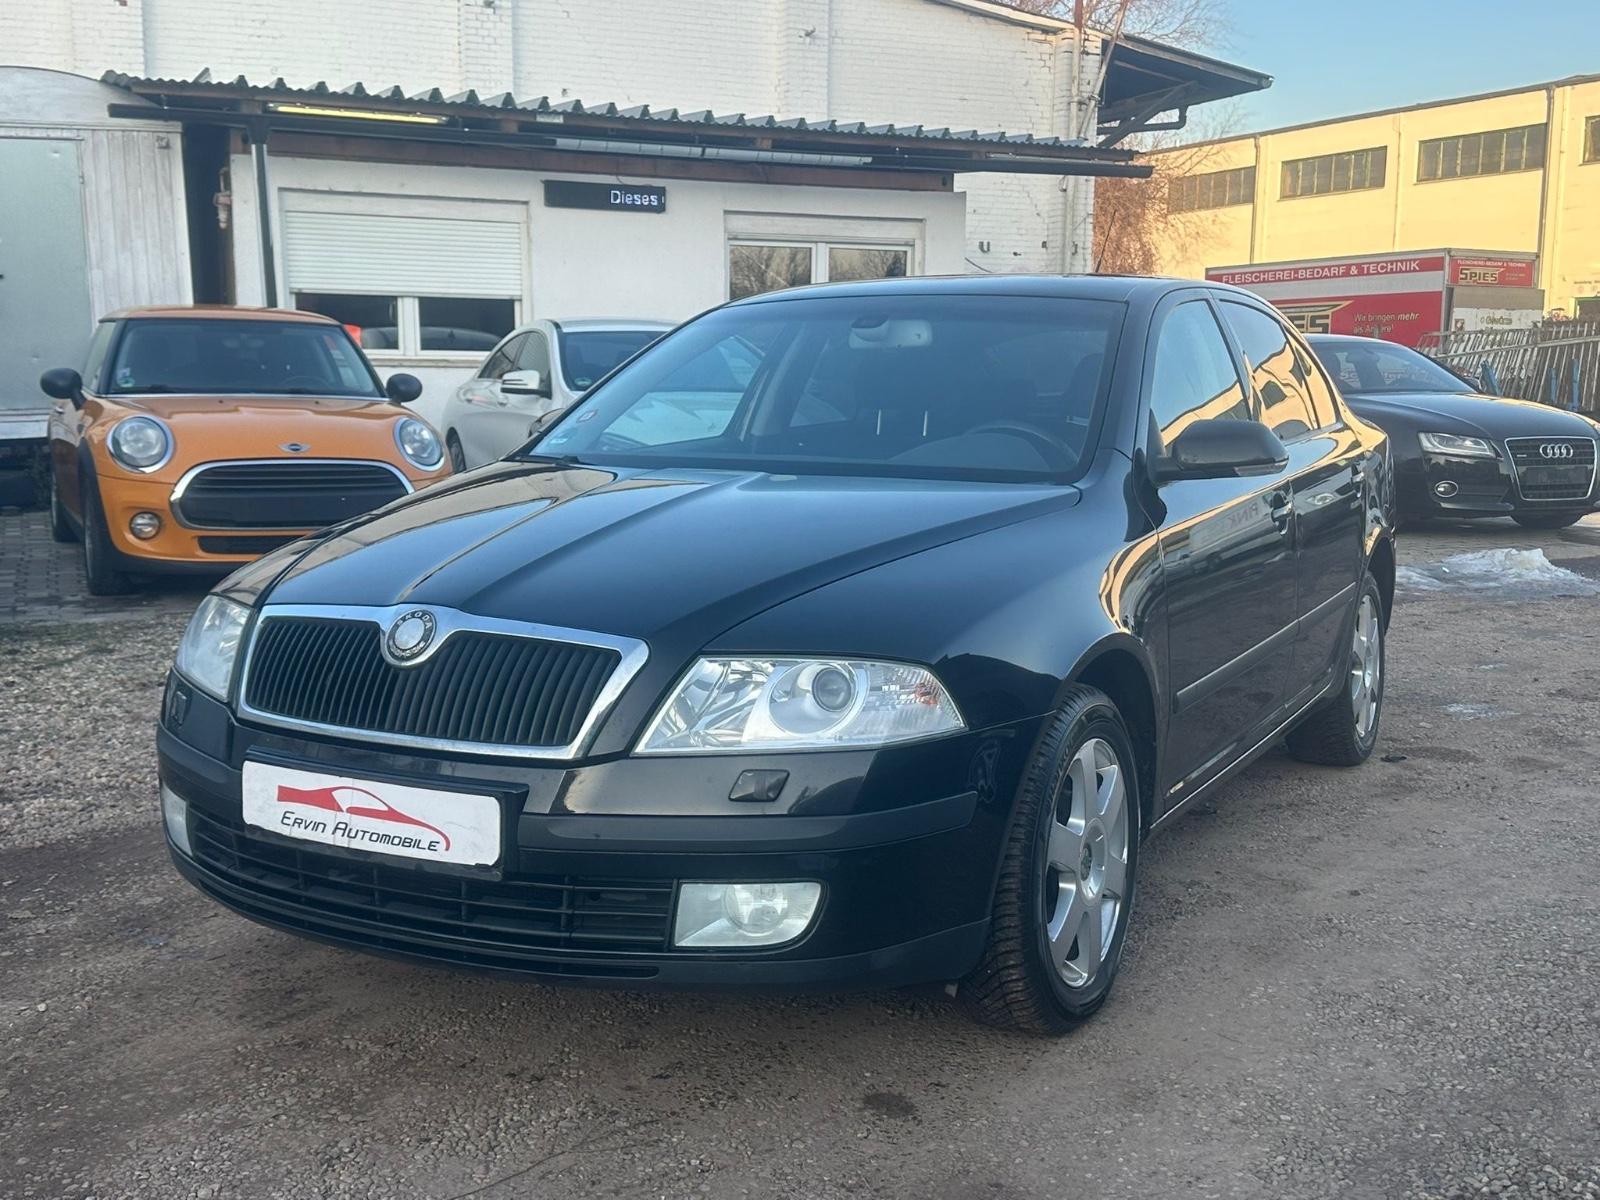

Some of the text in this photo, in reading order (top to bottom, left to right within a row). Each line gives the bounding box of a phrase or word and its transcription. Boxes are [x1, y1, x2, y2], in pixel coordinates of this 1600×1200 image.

[610, 190, 658, 206] Dieses
[1222, 260, 1420, 284] FLEISCHEREI-BEDARF & TECHNIK
[1459, 267, 1498, 283] SPIES
[1397, 312, 1420, 321] mehr
[280, 811, 440, 852] ERVIN AUTOMOBILE
